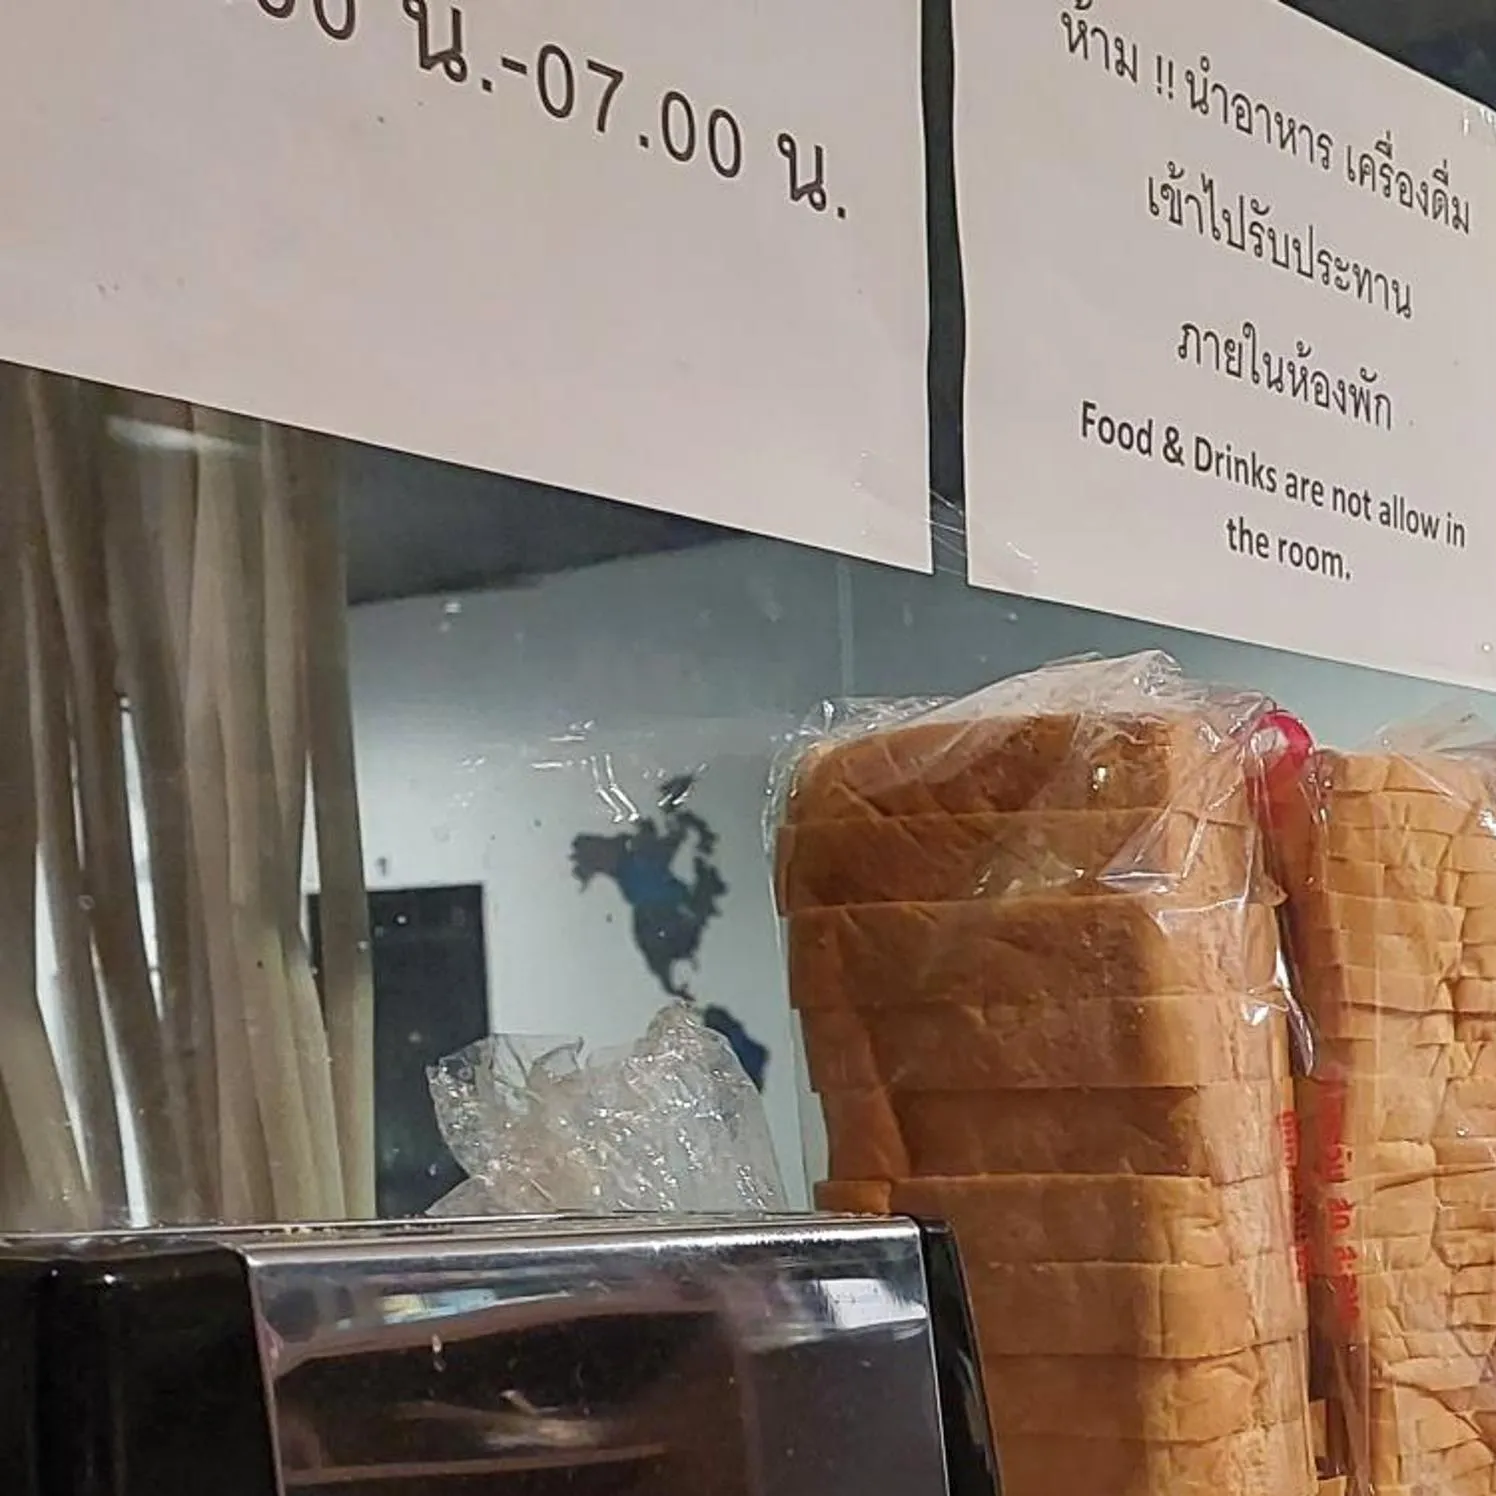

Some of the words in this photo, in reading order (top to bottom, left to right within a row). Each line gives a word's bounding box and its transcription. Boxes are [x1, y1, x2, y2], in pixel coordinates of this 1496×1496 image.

[777, 132, 846, 219] น.
[1060, 0, 1138, 83] ห้าม
[1344, 129, 1470, 235] เครื่องดื่ม
[1146, 160, 1412, 319] เข้าไปรับประทาน
[1177, 322, 1393, 430] ภายในห้องพัก
[1081, 400, 1154, 456] Food
[1162, 426, 1185, 465] &
[1194, 436, 1277, 494] Drinks
[1285, 470, 1324, 507] are
[1332, 485, 1372, 522] not
[1379, 495, 1440, 539] allow
[1445, 511, 1467, 548] in
[1225, 515, 1270, 559] the
[1278, 535, 1353, 581] room.
